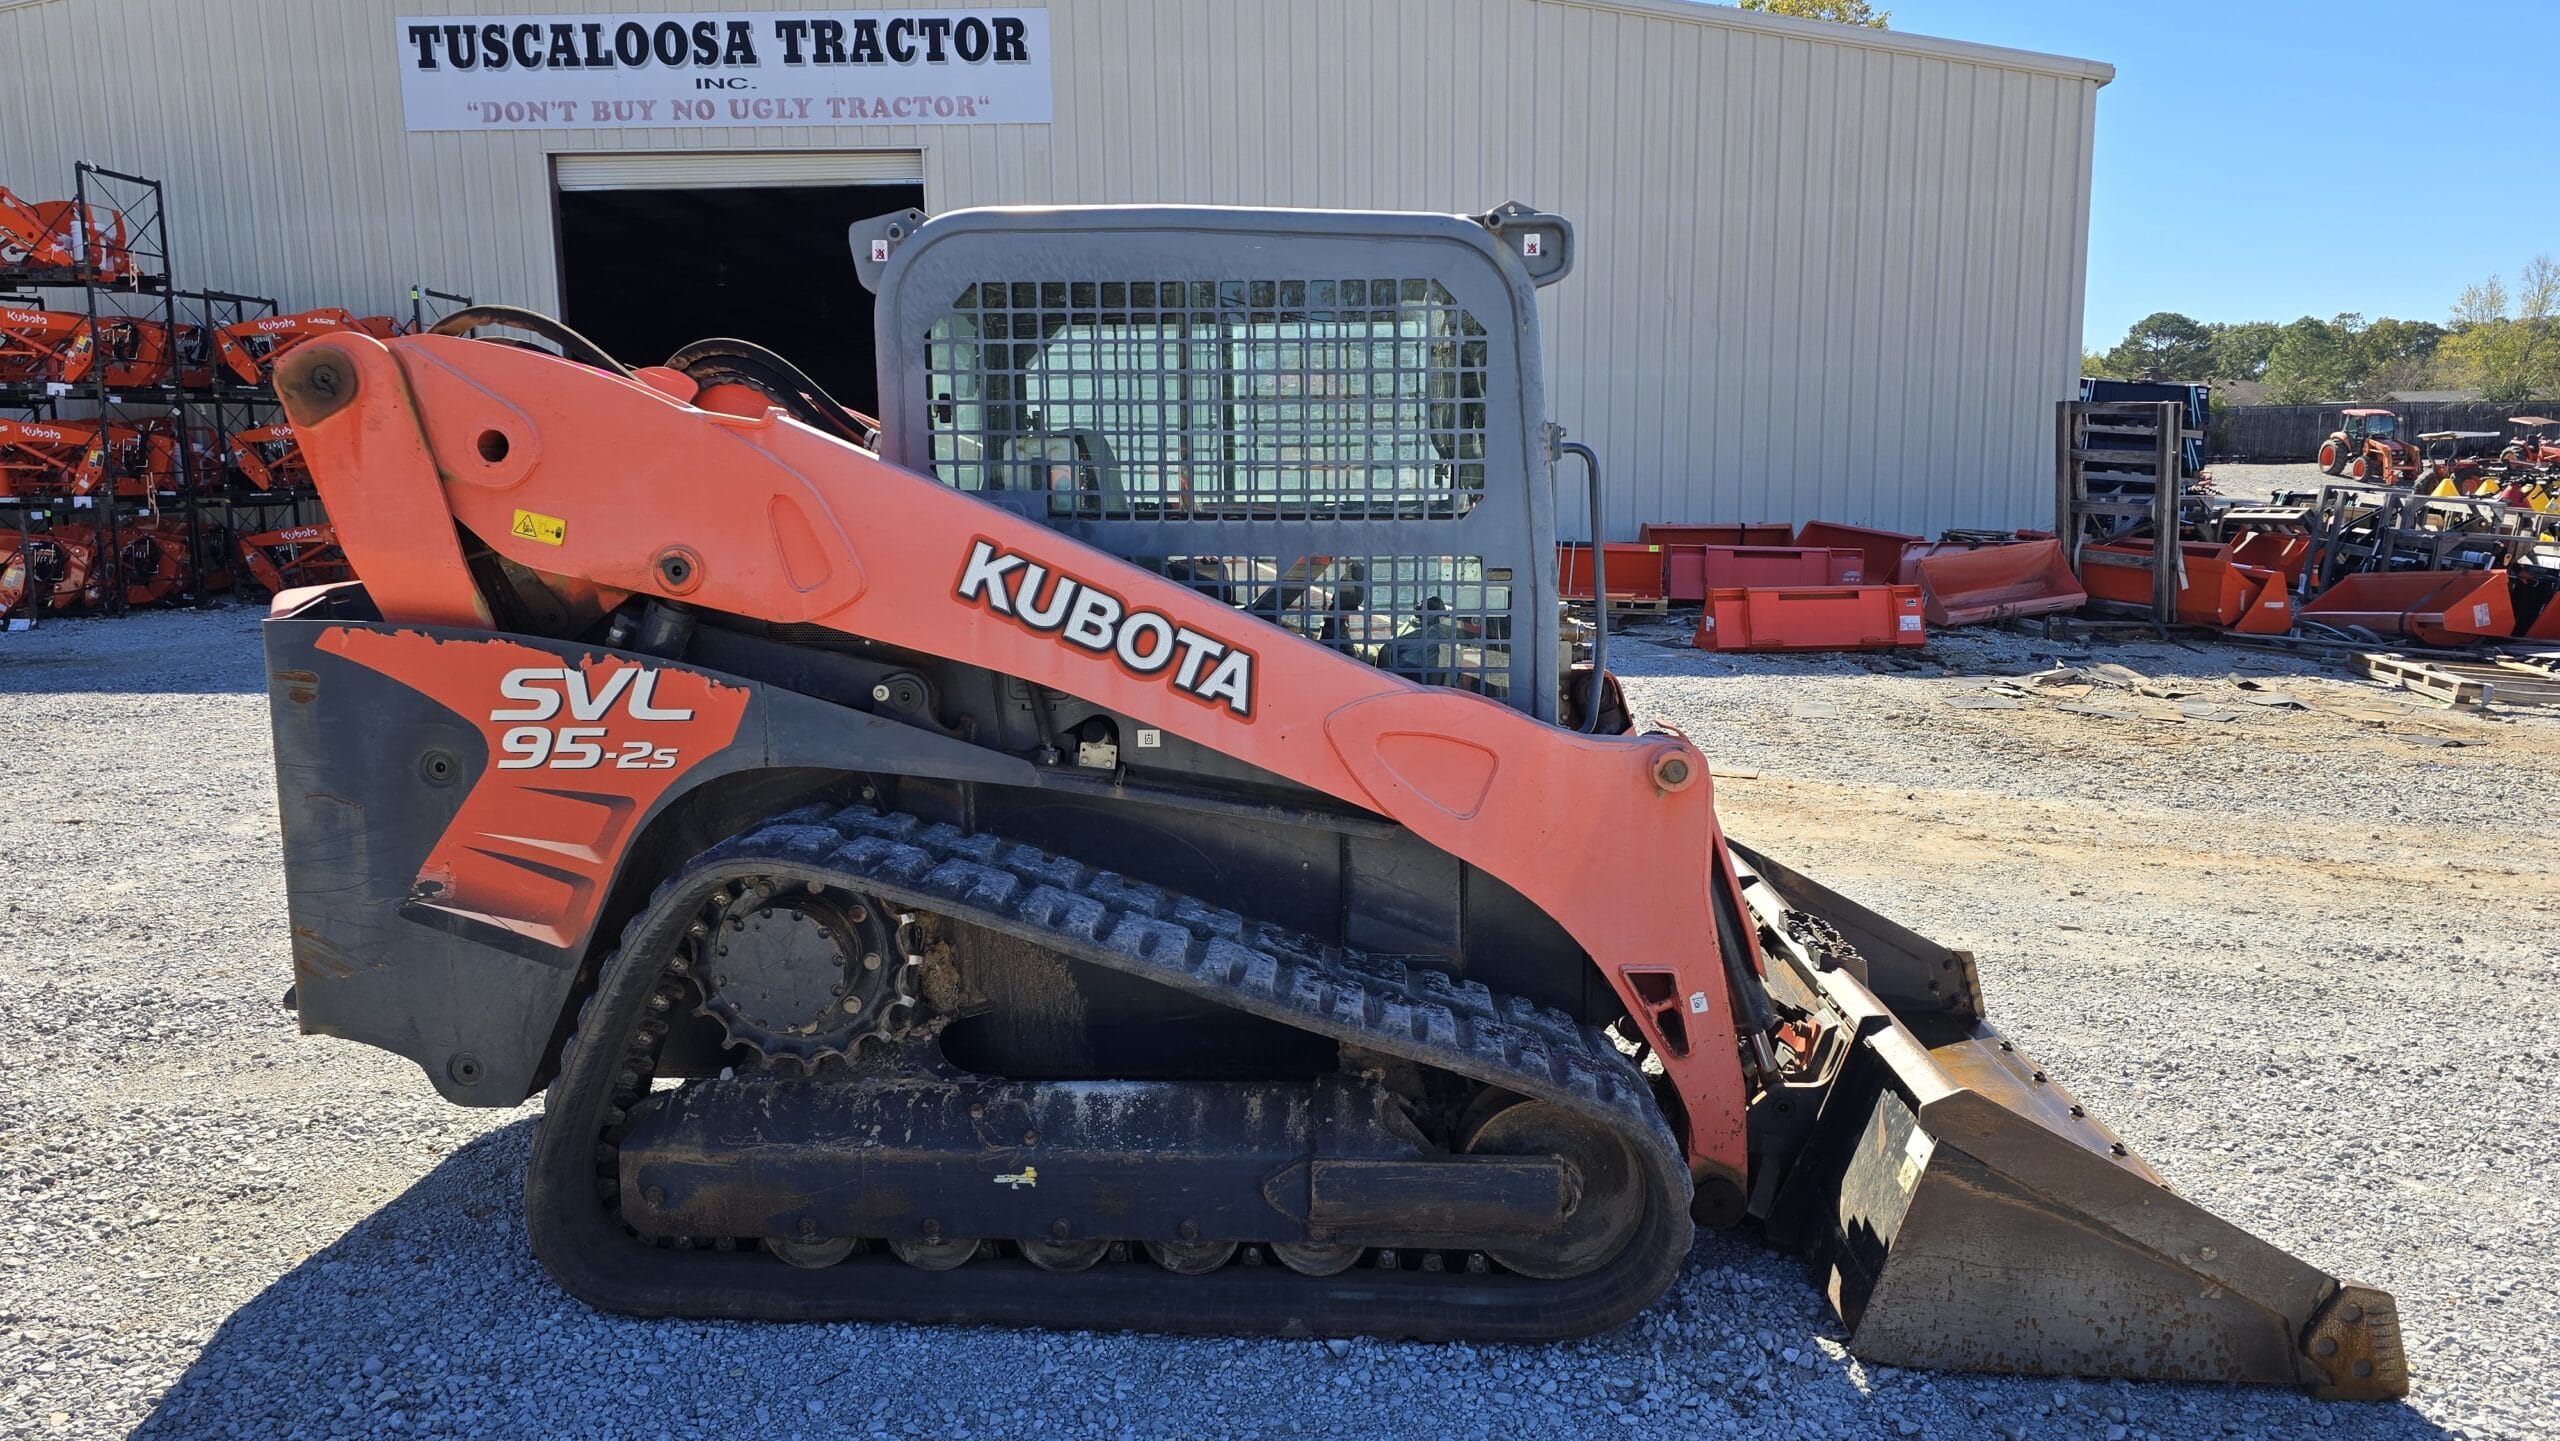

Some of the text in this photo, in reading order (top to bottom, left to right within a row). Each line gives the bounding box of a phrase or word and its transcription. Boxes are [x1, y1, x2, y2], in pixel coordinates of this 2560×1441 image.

[408, 16, 1030, 70] TUSCALOOSA TRACTOR
[695, 78, 757, 90] INC.
[591, 100, 657, 122] BUY
[672, 99, 716, 121] NO
[728, 98, 814, 120] UGLY
[7, 311, 48, 325] Kubota
[258, 319, 296, 331] Kubota
[21, 426, 61, 439] Kubota
[281, 528, 318, 540] Kubota
[957, 540, 1251, 716] KUBOTA
[489, 667, 694, 722] SVL
